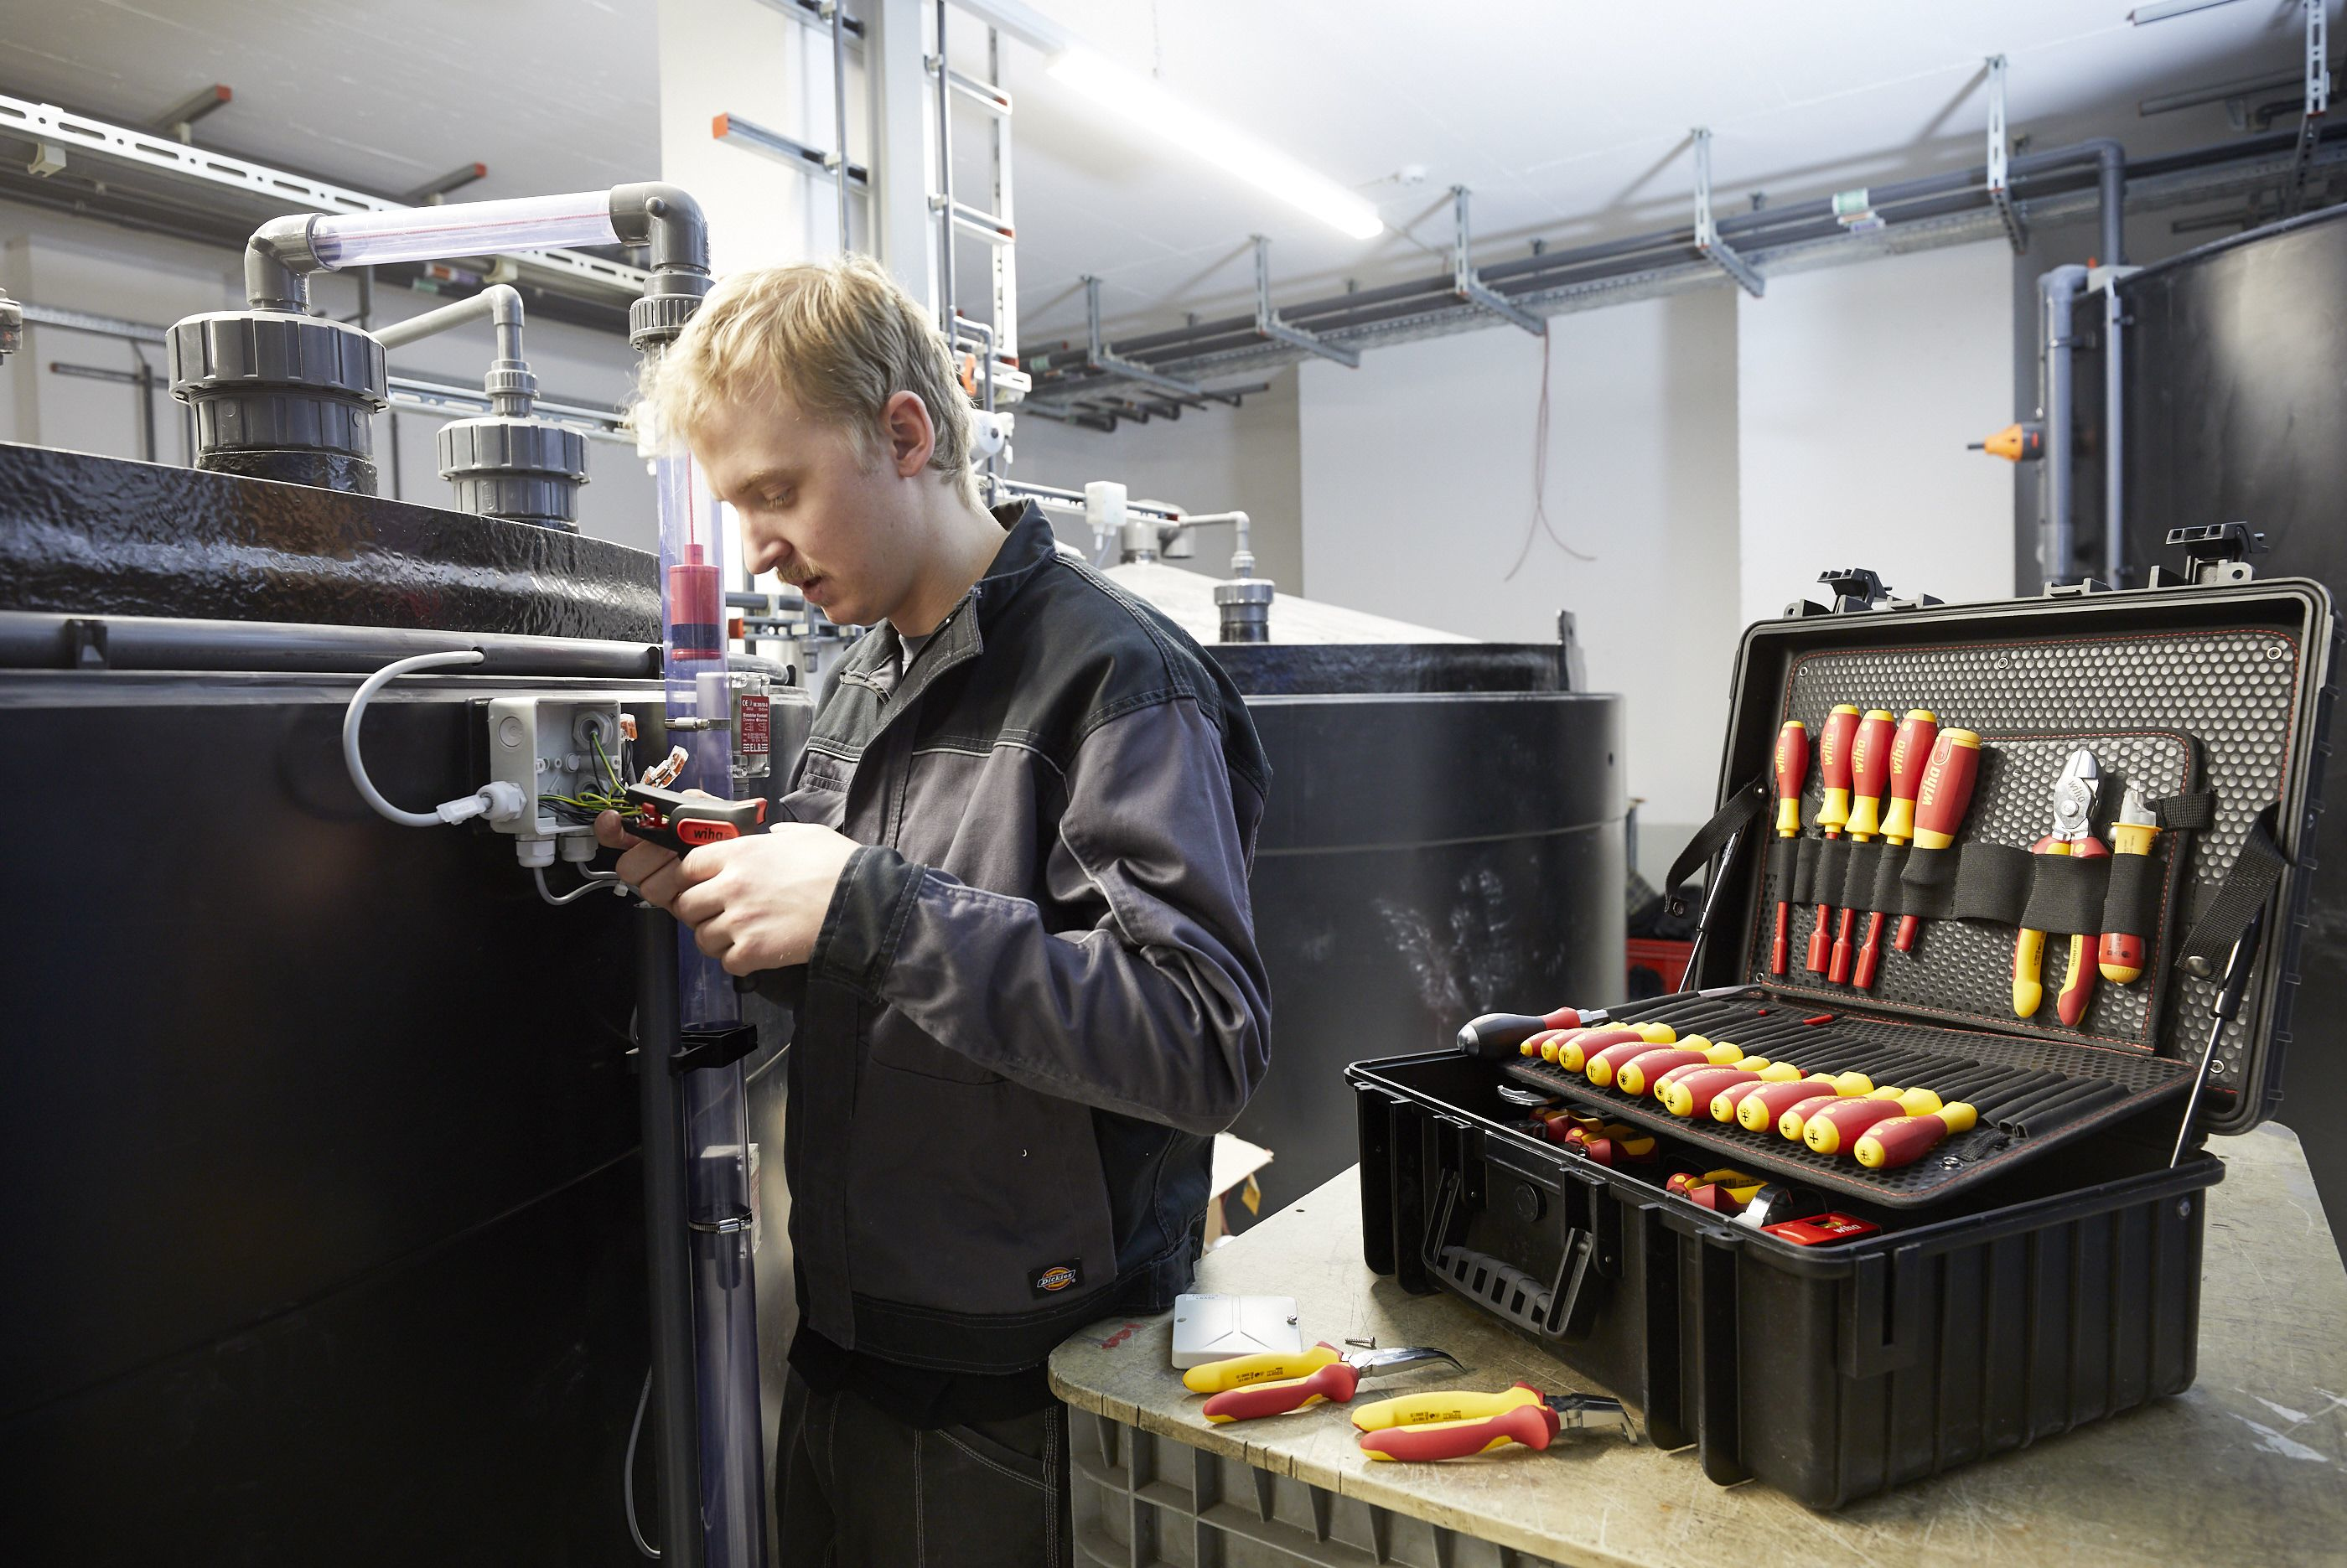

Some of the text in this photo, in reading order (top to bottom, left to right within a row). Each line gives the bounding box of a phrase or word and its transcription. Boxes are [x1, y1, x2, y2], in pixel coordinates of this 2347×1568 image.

[1775, 746, 1785, 774] wiha
[1822, 732, 1834, 765] wiha
[1853, 739, 1866, 774] wiha
[1892, 739, 1906, 774] wiha
[1921, 766, 1940, 806] wiha
[2068, 780, 2086, 803] wiha
[693, 827, 723, 841] wiha
[1885, 1116, 1917, 1126] wiha
[1833, 1224, 1862, 1233] wiha
[1040, 1272, 1073, 1286] Dickies
